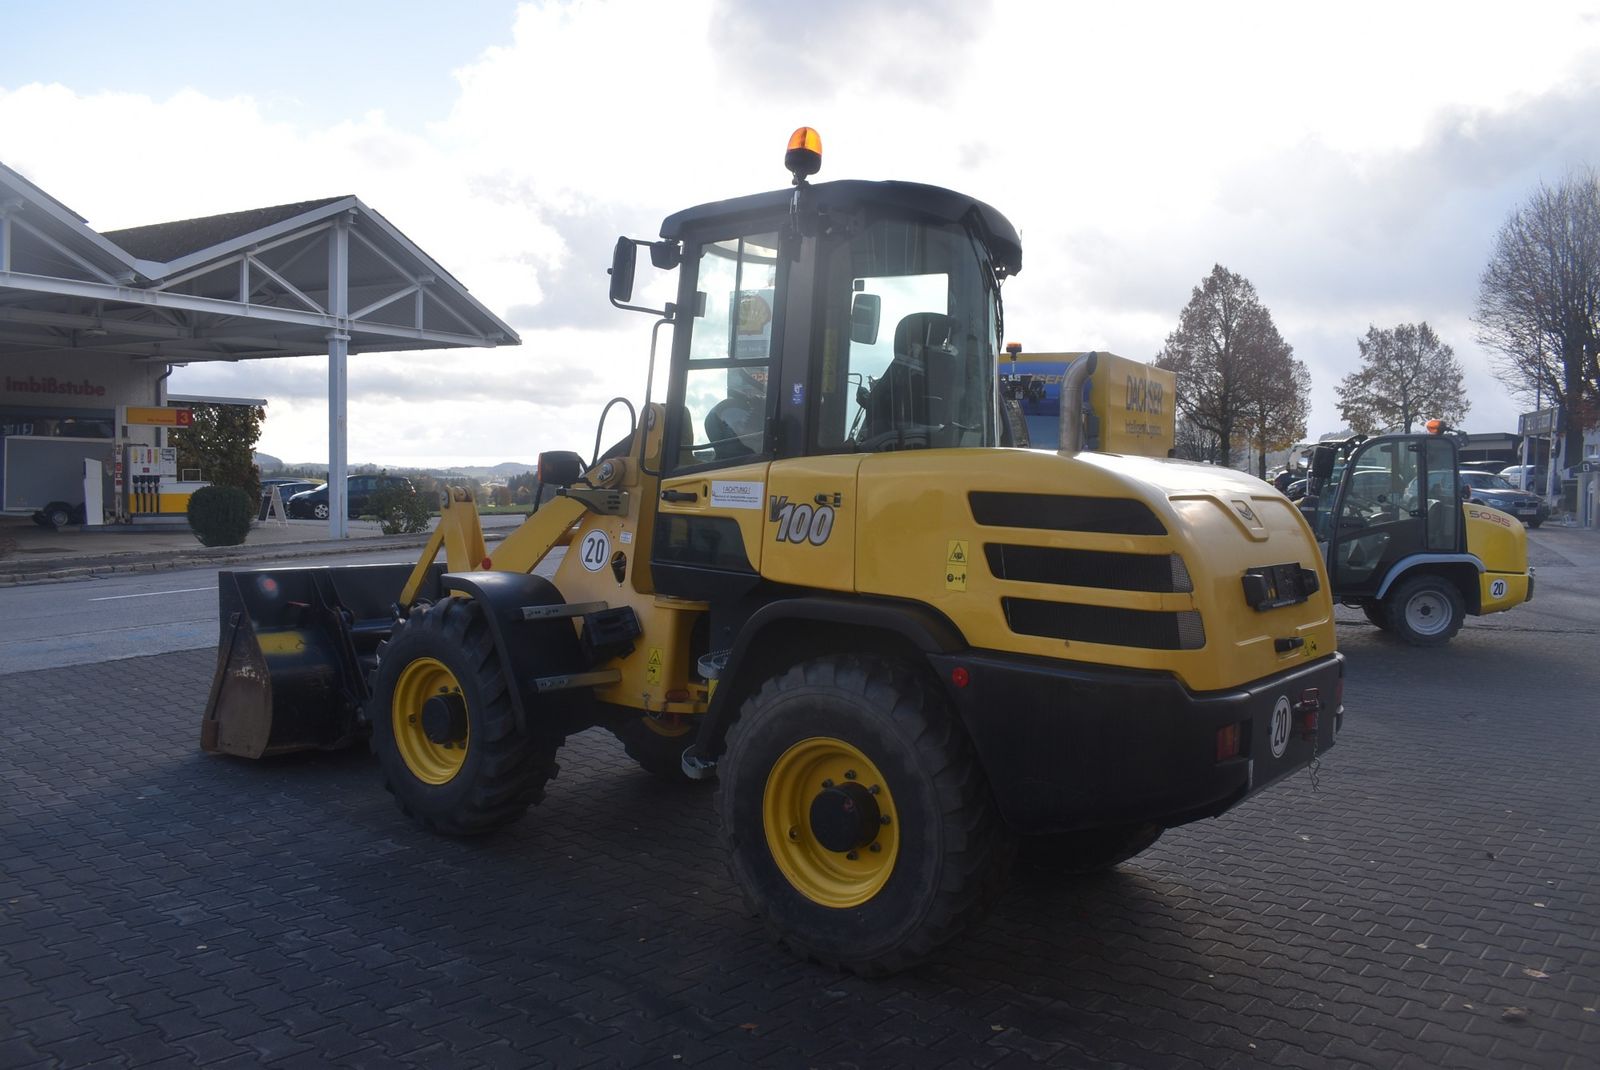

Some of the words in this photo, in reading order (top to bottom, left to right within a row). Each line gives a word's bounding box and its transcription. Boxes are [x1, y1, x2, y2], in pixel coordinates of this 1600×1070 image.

[5, 376, 105, 396] Imbißstube
[180, 411, 189, 424] 3
[1469, 510, 1511, 528] 5035
[585, 537, 604, 564] 20
[1493, 582, 1503, 597] 20
[1273, 707, 1287, 746] 20
